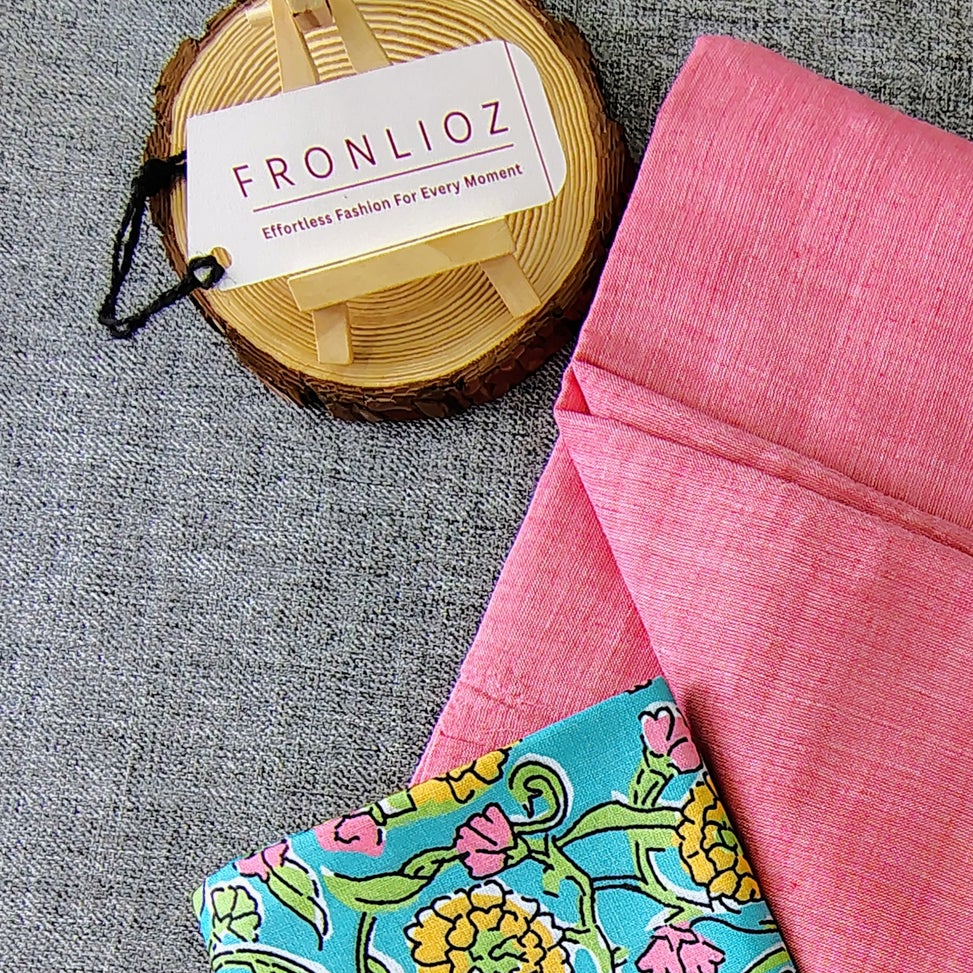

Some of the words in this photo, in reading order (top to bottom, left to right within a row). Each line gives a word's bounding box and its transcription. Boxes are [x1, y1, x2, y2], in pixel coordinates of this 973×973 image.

[232, 101, 509, 197] FRONLIOZ
[261, 211, 333, 240] Effortless
[334, 198, 391, 222] Fashion
[393, 190, 418, 208] For
[422, 179, 461, 204] Every
[464, 162, 523, 189] Moment
